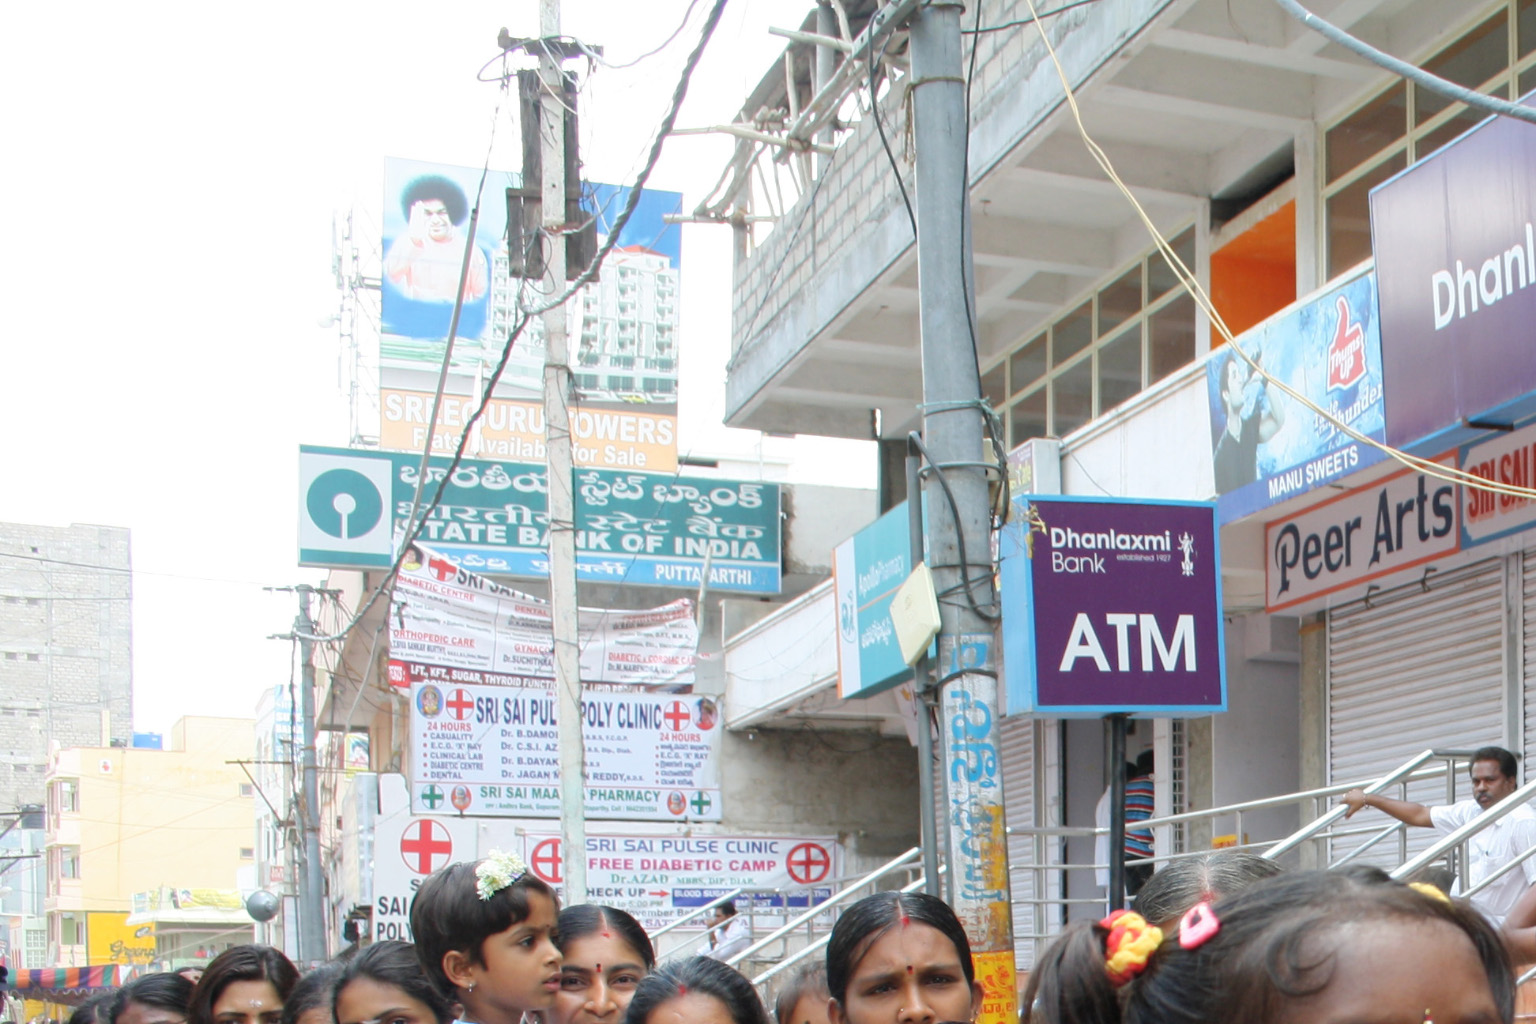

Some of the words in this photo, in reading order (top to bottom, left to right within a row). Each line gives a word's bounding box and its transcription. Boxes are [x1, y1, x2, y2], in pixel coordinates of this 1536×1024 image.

[1330, 335, 1361, 374] Thums
[412, 427, 461, 450] Fats
[603, 445, 647, 467] Sale
[1268, 468, 1303, 498] MANU
[1306, 445, 1359, 485] SWEETS
[1468, 457, 1495, 518] SRI
[1500, 444, 1529, 508] SAI
[402, 519, 508, 545] STATE
[621, 533, 664, 554] OF
[674, 537, 763, 560] INDIA
[1050, 527, 1171, 551] Dhanlaxmi
[1275, 516, 1363, 599] Peer
[1368, 475, 1453, 569] Arts
[1052, 551, 1106, 574] Bank
[1116, 554, 1154, 562] established
[1155, 554, 1171, 562] 1927
[655, 564, 752, 585] PUTTAARTHI
[393, 629, 449, 644] ORTHOPEDIC
[451, 636, 475, 648] CARE
[1059, 613, 1197, 672] ATM
[476, 697, 499, 724] SRI
[503, 698, 526, 725] SAI
[530, 699, 557, 727] PUL
[617, 702, 662, 731] CLINIC
[427, 721, 438, 731] 24
[440, 722, 472, 732] HOURS
[501, 729, 514, 738] Dr.
[659, 732, 669, 742] 24
[671, 733, 700, 743] HOURS
[501, 742, 514, 751] Dr.
[430, 752, 466, 761] CLINICAL
[468, 753, 484, 761] LAB
[501, 756, 514, 765] Dr.
[516, 757, 559, 767] B.DAYAK
[430, 761, 458, 771] DIABETIC
[460, 762, 484, 771] CENTRE
[430, 771, 463, 780] DENTAL
[501, 770, 514, 779] Dr.
[517, 771, 551, 780] JAGAN
[480, 786, 502, 799] SRI
[506, 787, 527, 800] SAI
[590, 789, 661, 803] PHARMACY
[586, 838, 617, 852] SRI
[623, 839, 654, 853] SAI
[661, 840, 719, 854] PULSE
[725, 841, 780, 855] CLINIC
[588, 857, 634, 870] FREE
[640, 858, 722, 872] DIABETIC
[728, 859, 777, 873] CAMP
[610, 873, 669, 885] Dr.AZAD
[586, 887, 623, 898] HECK
[628, 888, 646, 898] UP
[378, 896, 407, 916] SAI
